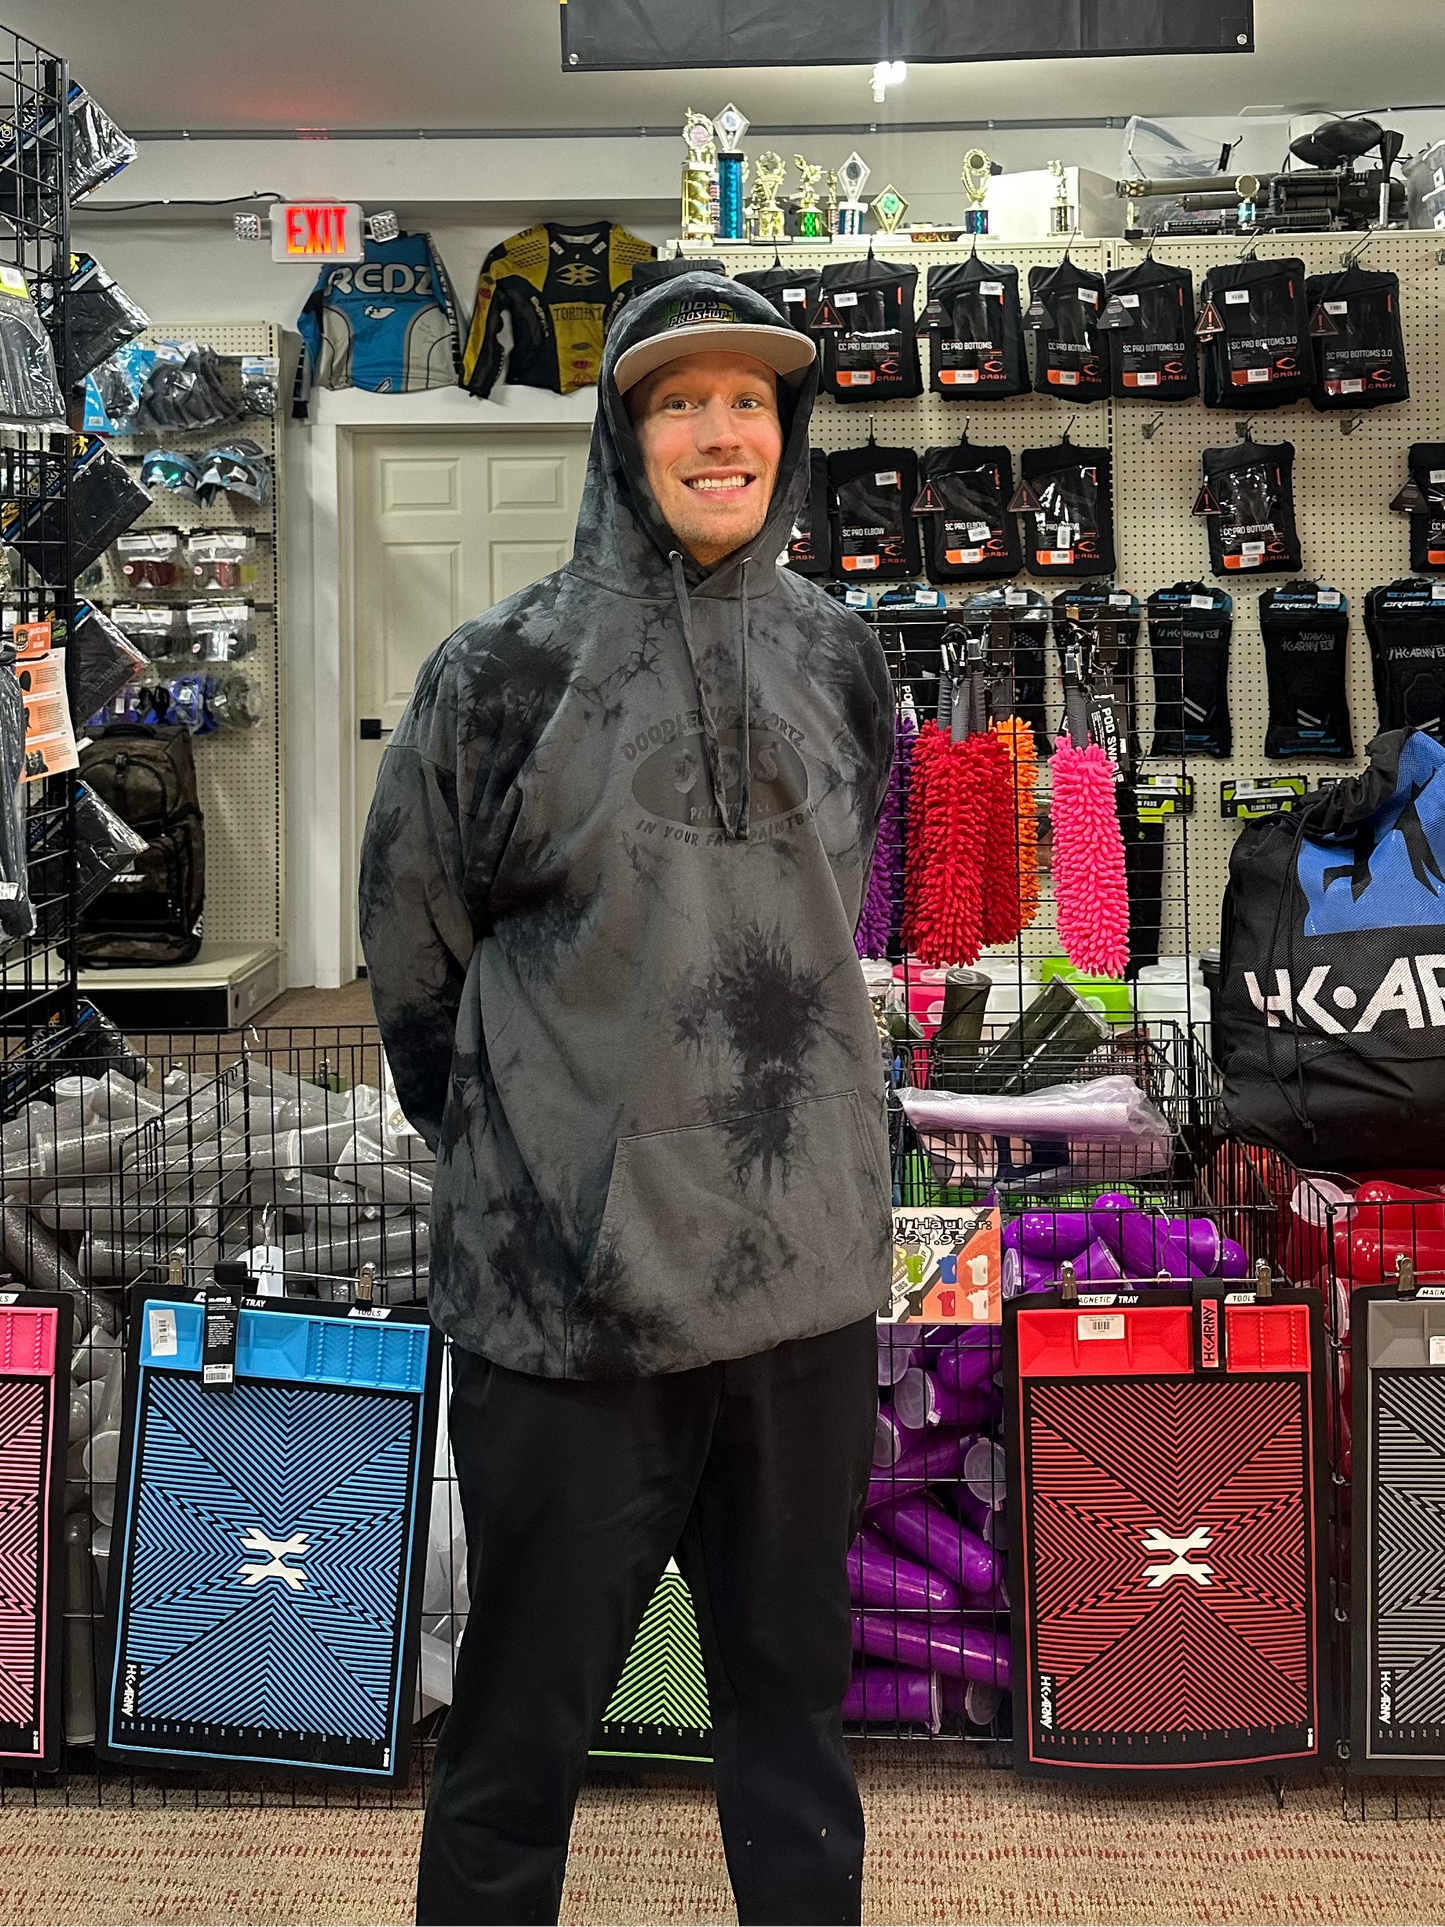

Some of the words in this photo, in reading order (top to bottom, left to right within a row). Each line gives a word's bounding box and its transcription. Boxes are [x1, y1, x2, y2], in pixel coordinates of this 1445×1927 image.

[285, 206, 348, 254] EXIT
[669, 309, 728, 327] PROSHOP
[838, 343, 847, 351] CC
[848, 343, 860, 351] PRO
[861, 342, 889, 350] BOTTOMS
[941, 343, 950, 351] CC
[951, 342, 964, 351] PRO
[964, 342, 993, 350] BOTTOMS
[1048, 343, 1056, 351] CC
[1056, 343, 1067, 351] PRO
[1231, 341, 1241, 350] SC
[1241, 340, 1254, 349] PRO
[1255, 337, 1285, 348] BOTTOMS
[1286, 335, 1298, 345] 3.0
[1122, 345, 1131, 353] SC
[1146, 344, 1173, 352] BOTTOMS
[1174, 343, 1185, 351] 3.0
[1326, 351, 1335, 360] SC
[1336, 351, 1349, 359] PRO
[1350, 350, 1380, 359] BOTTOMS
[1381, 349, 1392, 357] 3.0
[1273, 370, 1301, 378] CRBN
[945, 522, 954, 531] SC
[953, 522, 966, 530] PRO
[1046, 523, 1058, 531] PRO
[1233, 526, 1245, 535] PRO
[1246, 523, 1275, 533] BOTTOMS
[1431, 522, 1440, 531] CC
[842, 528, 851, 537] SC
[852, 527, 864, 536] PRO
[864, 527, 885, 535] ELBOW
[1269, 602, 1317, 611] CRASH
[1382, 600, 1431, 609] CRASH
[1102, 707, 1116, 734] POD
[1266, 803, 1279, 811] PADS
[635, 818, 656, 835] IN
[664, 826, 699, 846] YOUR
[914, 1217, 993, 1230] Hauler:
[894, 1232, 966, 1246] $21.95
[894, 1280, 909, 1293] DBS
[246, 1299, 267, 1308] TRAY
[1078, 1296, 1112, 1304] AGNETIC
[1118, 1295, 1139, 1304] TRAY
